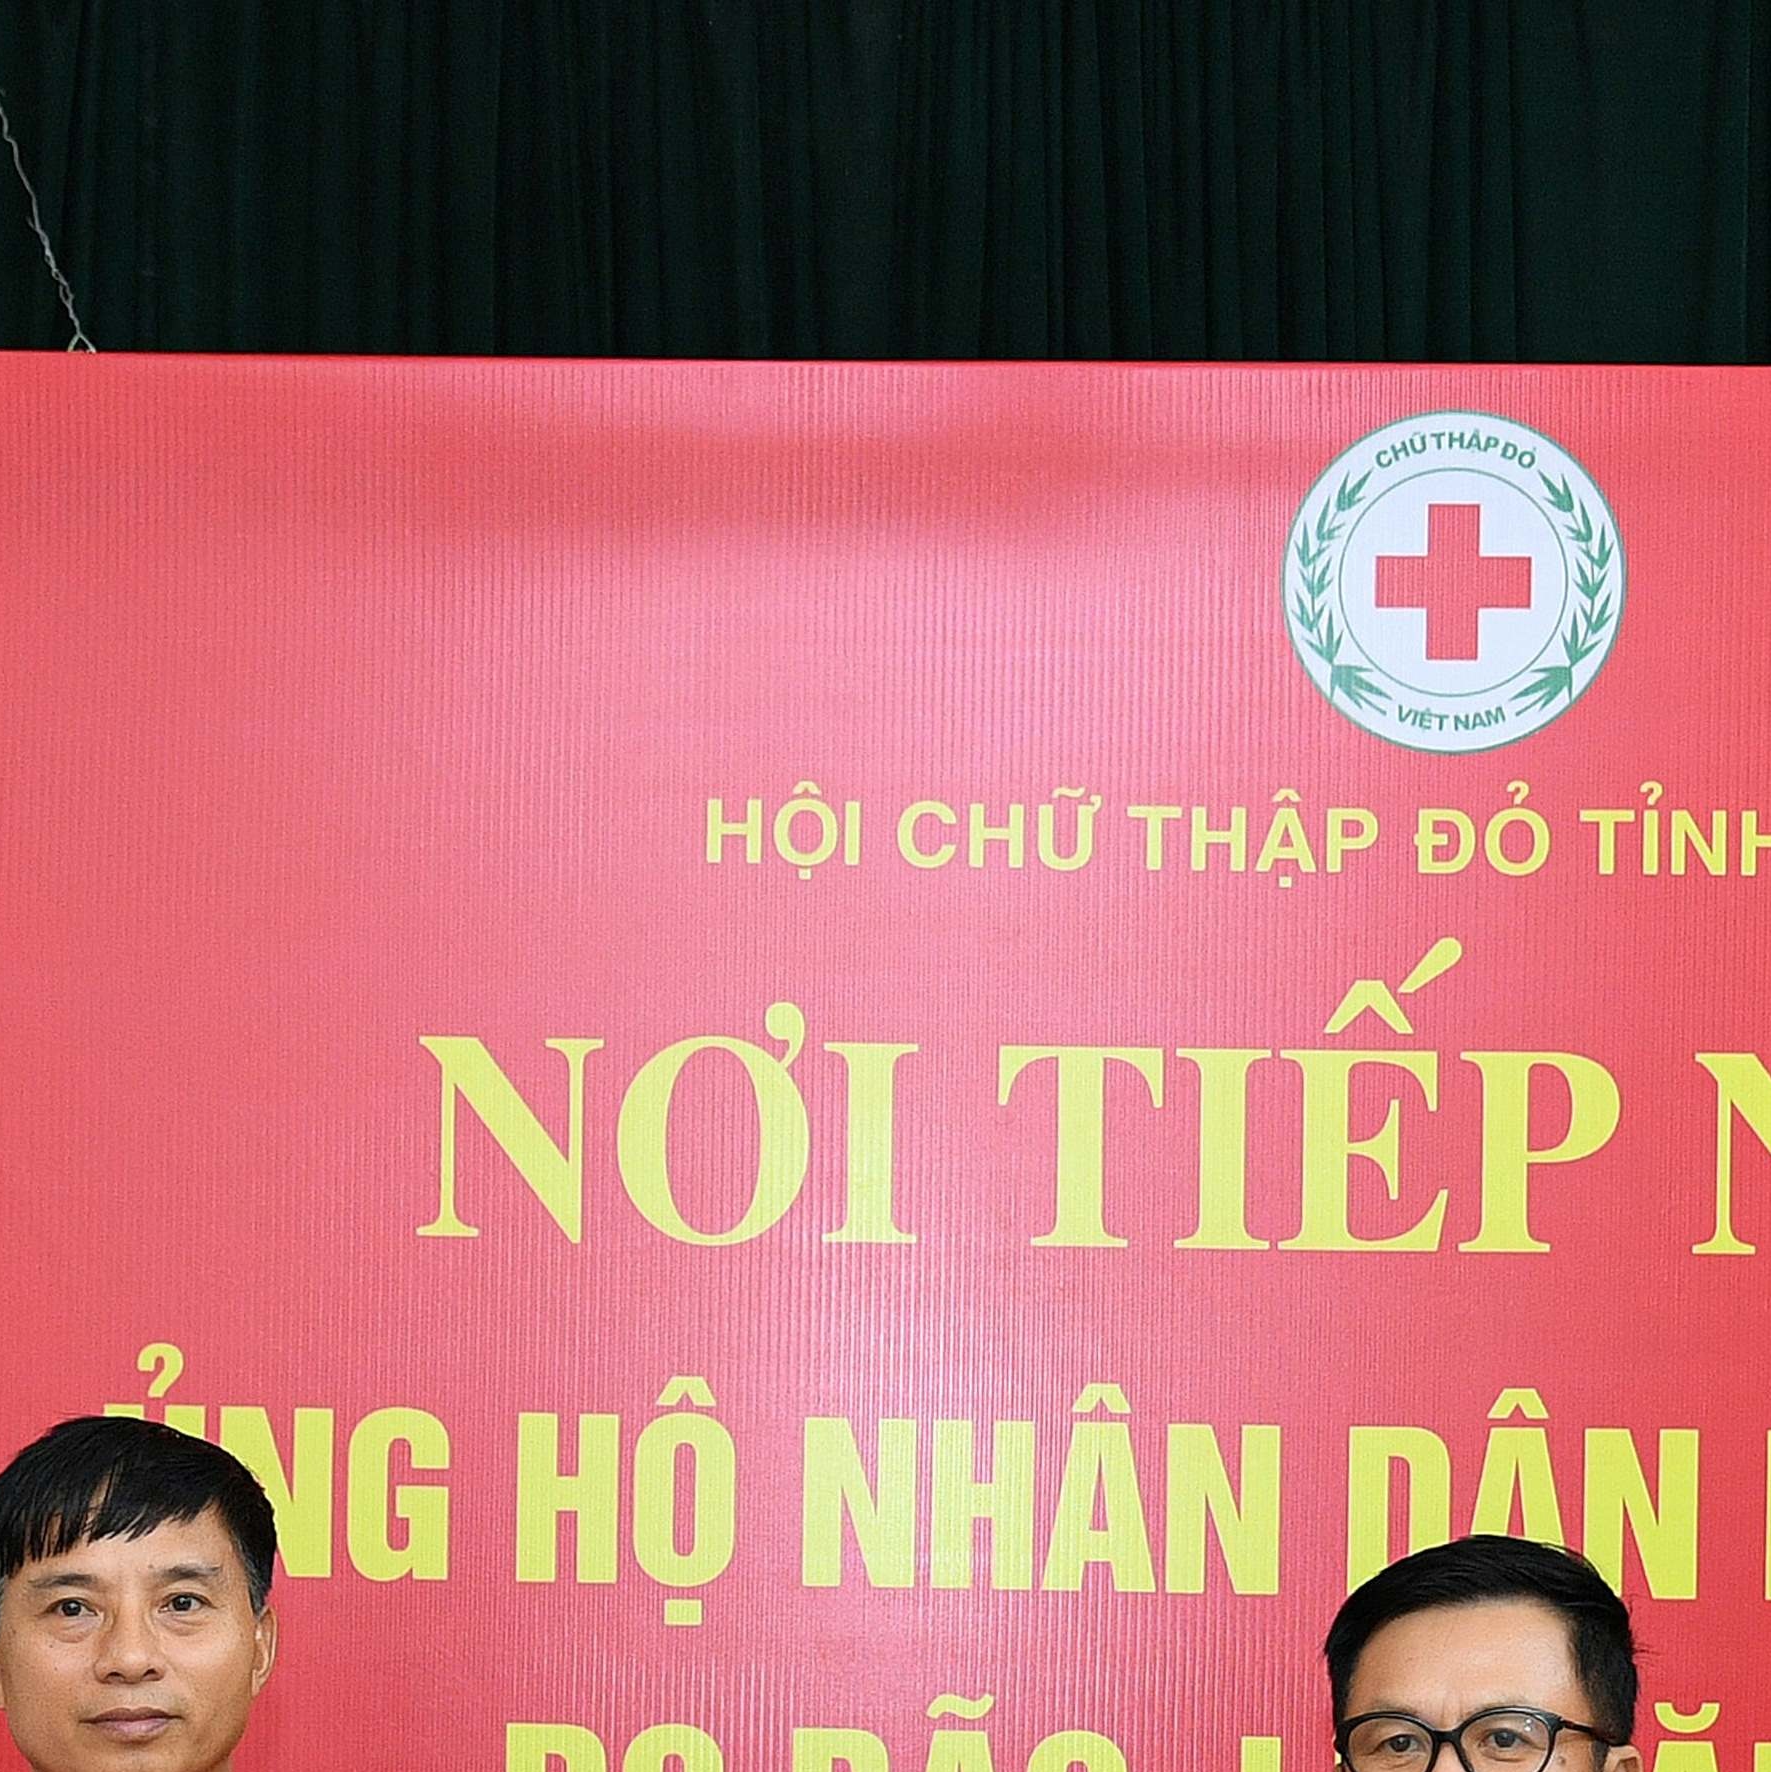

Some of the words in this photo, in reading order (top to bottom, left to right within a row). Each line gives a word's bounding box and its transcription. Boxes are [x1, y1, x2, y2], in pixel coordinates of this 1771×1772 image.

[1398, 704, 1450, 732] VIỆT
[1454, 706, 1506, 731] NAM
[706, 781, 861, 880] HỘI
[897, 786, 1101, 871] CHỮ
[1129, 788, 1379, 888] THẬP
[1414, 780, 1551, 875] ĐỎ
[418, 1003, 918, 1245] NƠI
[999, 937, 1621, 1253] TIẾP
[517, 1376, 736, 1626] HỘ
[804, 1383, 1282, 1596] NHÂN
[1347, 1387, 1700, 1600] DÂN
